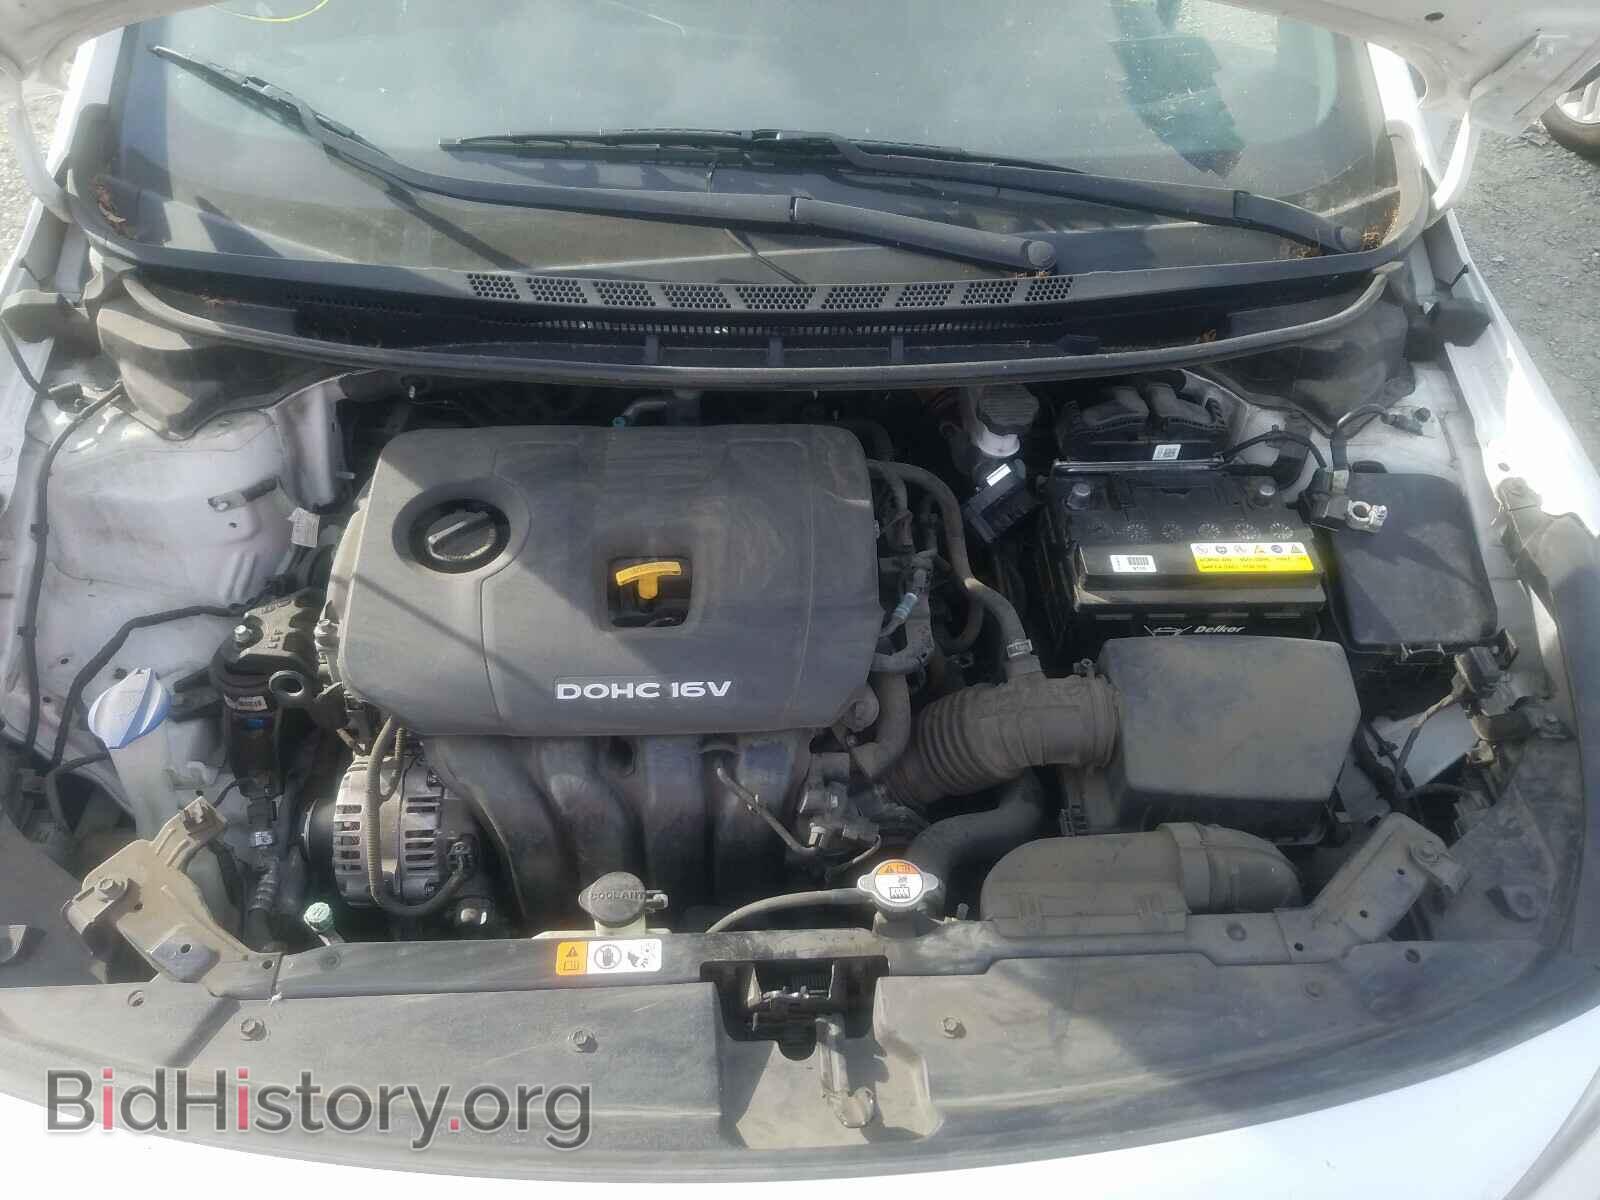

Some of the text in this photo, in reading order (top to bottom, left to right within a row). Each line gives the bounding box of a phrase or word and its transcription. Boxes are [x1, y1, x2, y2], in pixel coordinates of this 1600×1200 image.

[1193, 624, 1246, 633] Delkor
[556, 680, 732, 700] DOHC 16V
[590, 889, 644, 900] COOLANT
